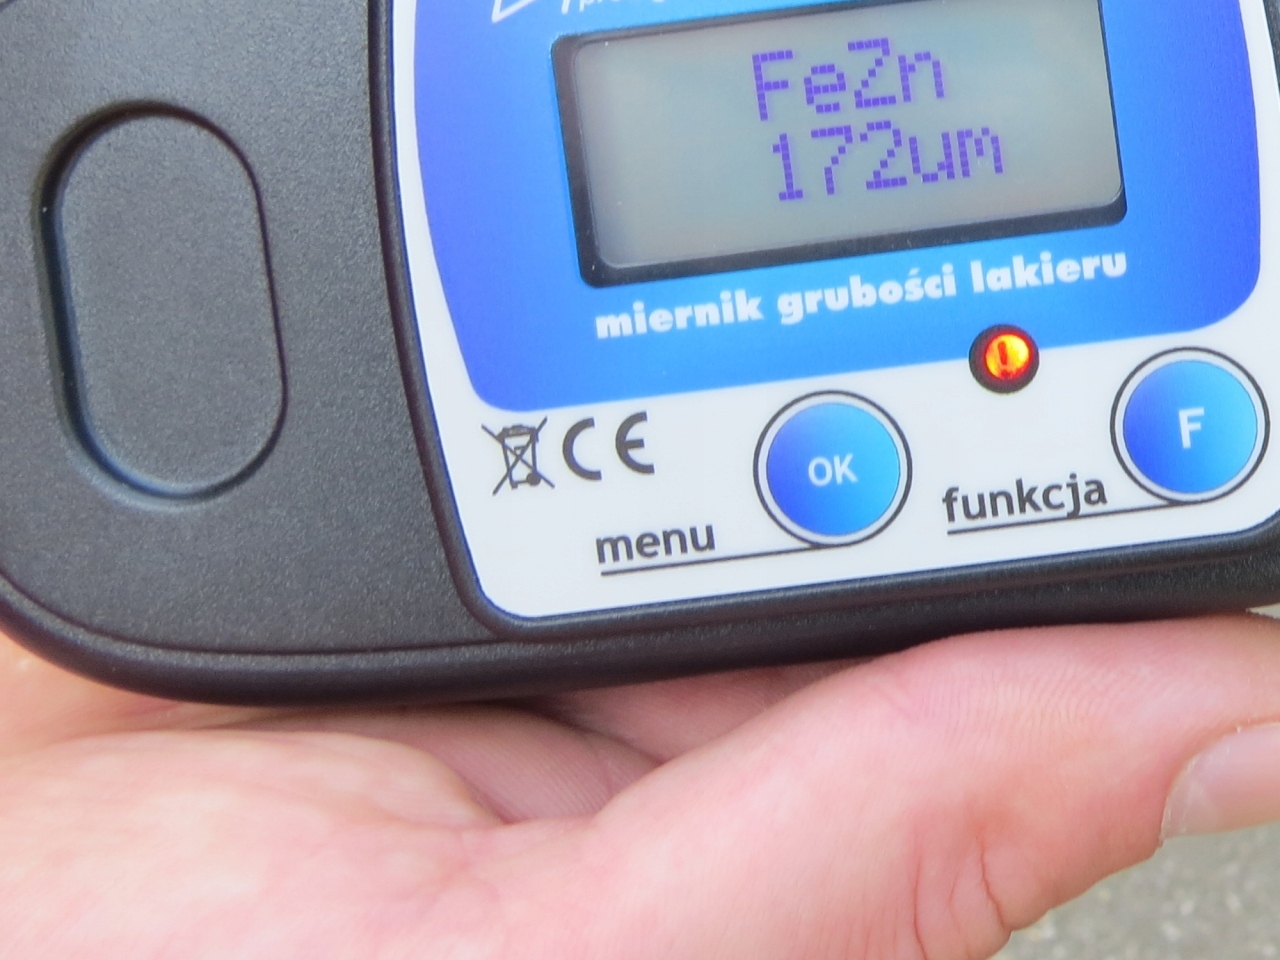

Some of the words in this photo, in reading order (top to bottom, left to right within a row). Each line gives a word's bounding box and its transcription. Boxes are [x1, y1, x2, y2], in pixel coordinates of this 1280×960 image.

[752, 37, 946, 122] FeZn
[772, 119, 1004, 202] 172um
[595, 289, 763, 341] miernik
[776, 263, 957, 326] grubości
[970, 247, 1129, 294] lakieru
[562, 410, 656, 482] CE
[1177, 407, 1206, 450] F
[807, 453, 859, 487] OK
[942, 473, 1108, 522] funkcja
[596, 524, 716, 565] menu
